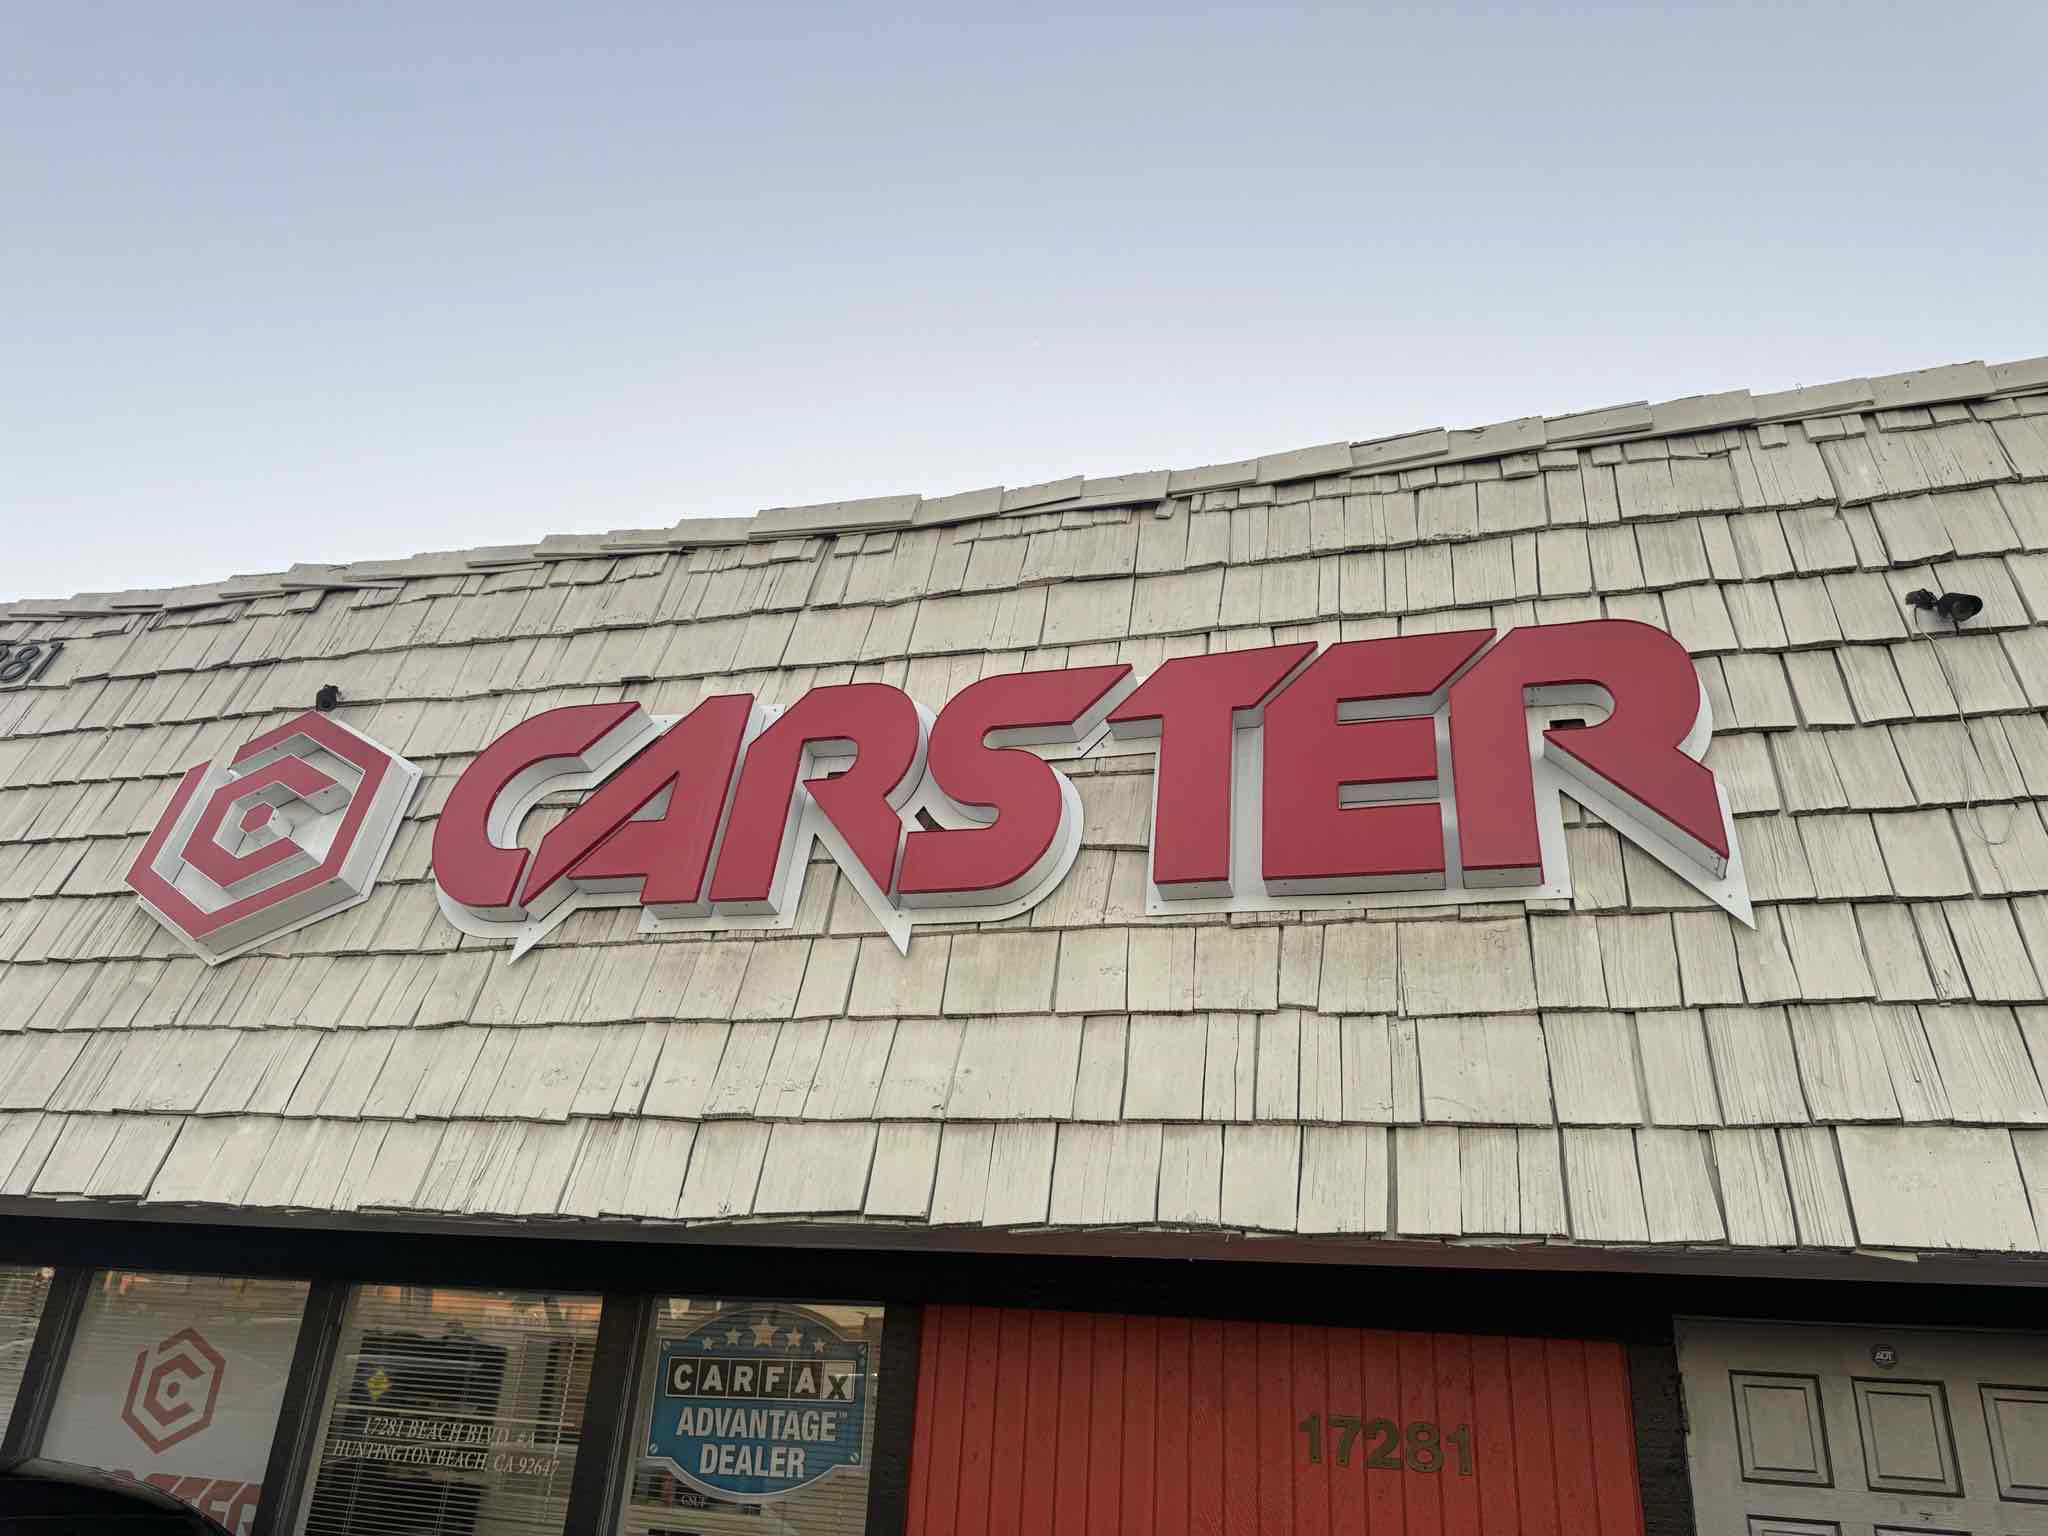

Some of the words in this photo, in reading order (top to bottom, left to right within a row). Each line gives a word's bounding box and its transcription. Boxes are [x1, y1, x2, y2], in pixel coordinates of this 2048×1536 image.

[0, 640, 64, 683] 81
[432, 618, 1730, 914] CARSTER
[1875, 1351, 1893, 1361] ADT
[672, 1362, 853, 1399] CARFAX
[363, 1416, 404, 1437] 17281
[408, 1419, 464, 1442] BEACH
[1299, 1413, 1473, 1476] 17281
[333, 1440, 432, 1464] HUNTINGTON
[494, 1455, 513, 1473] CA
[519, 1457, 560, 1478] 92647
[699, 1443, 806, 1479] DEALER
